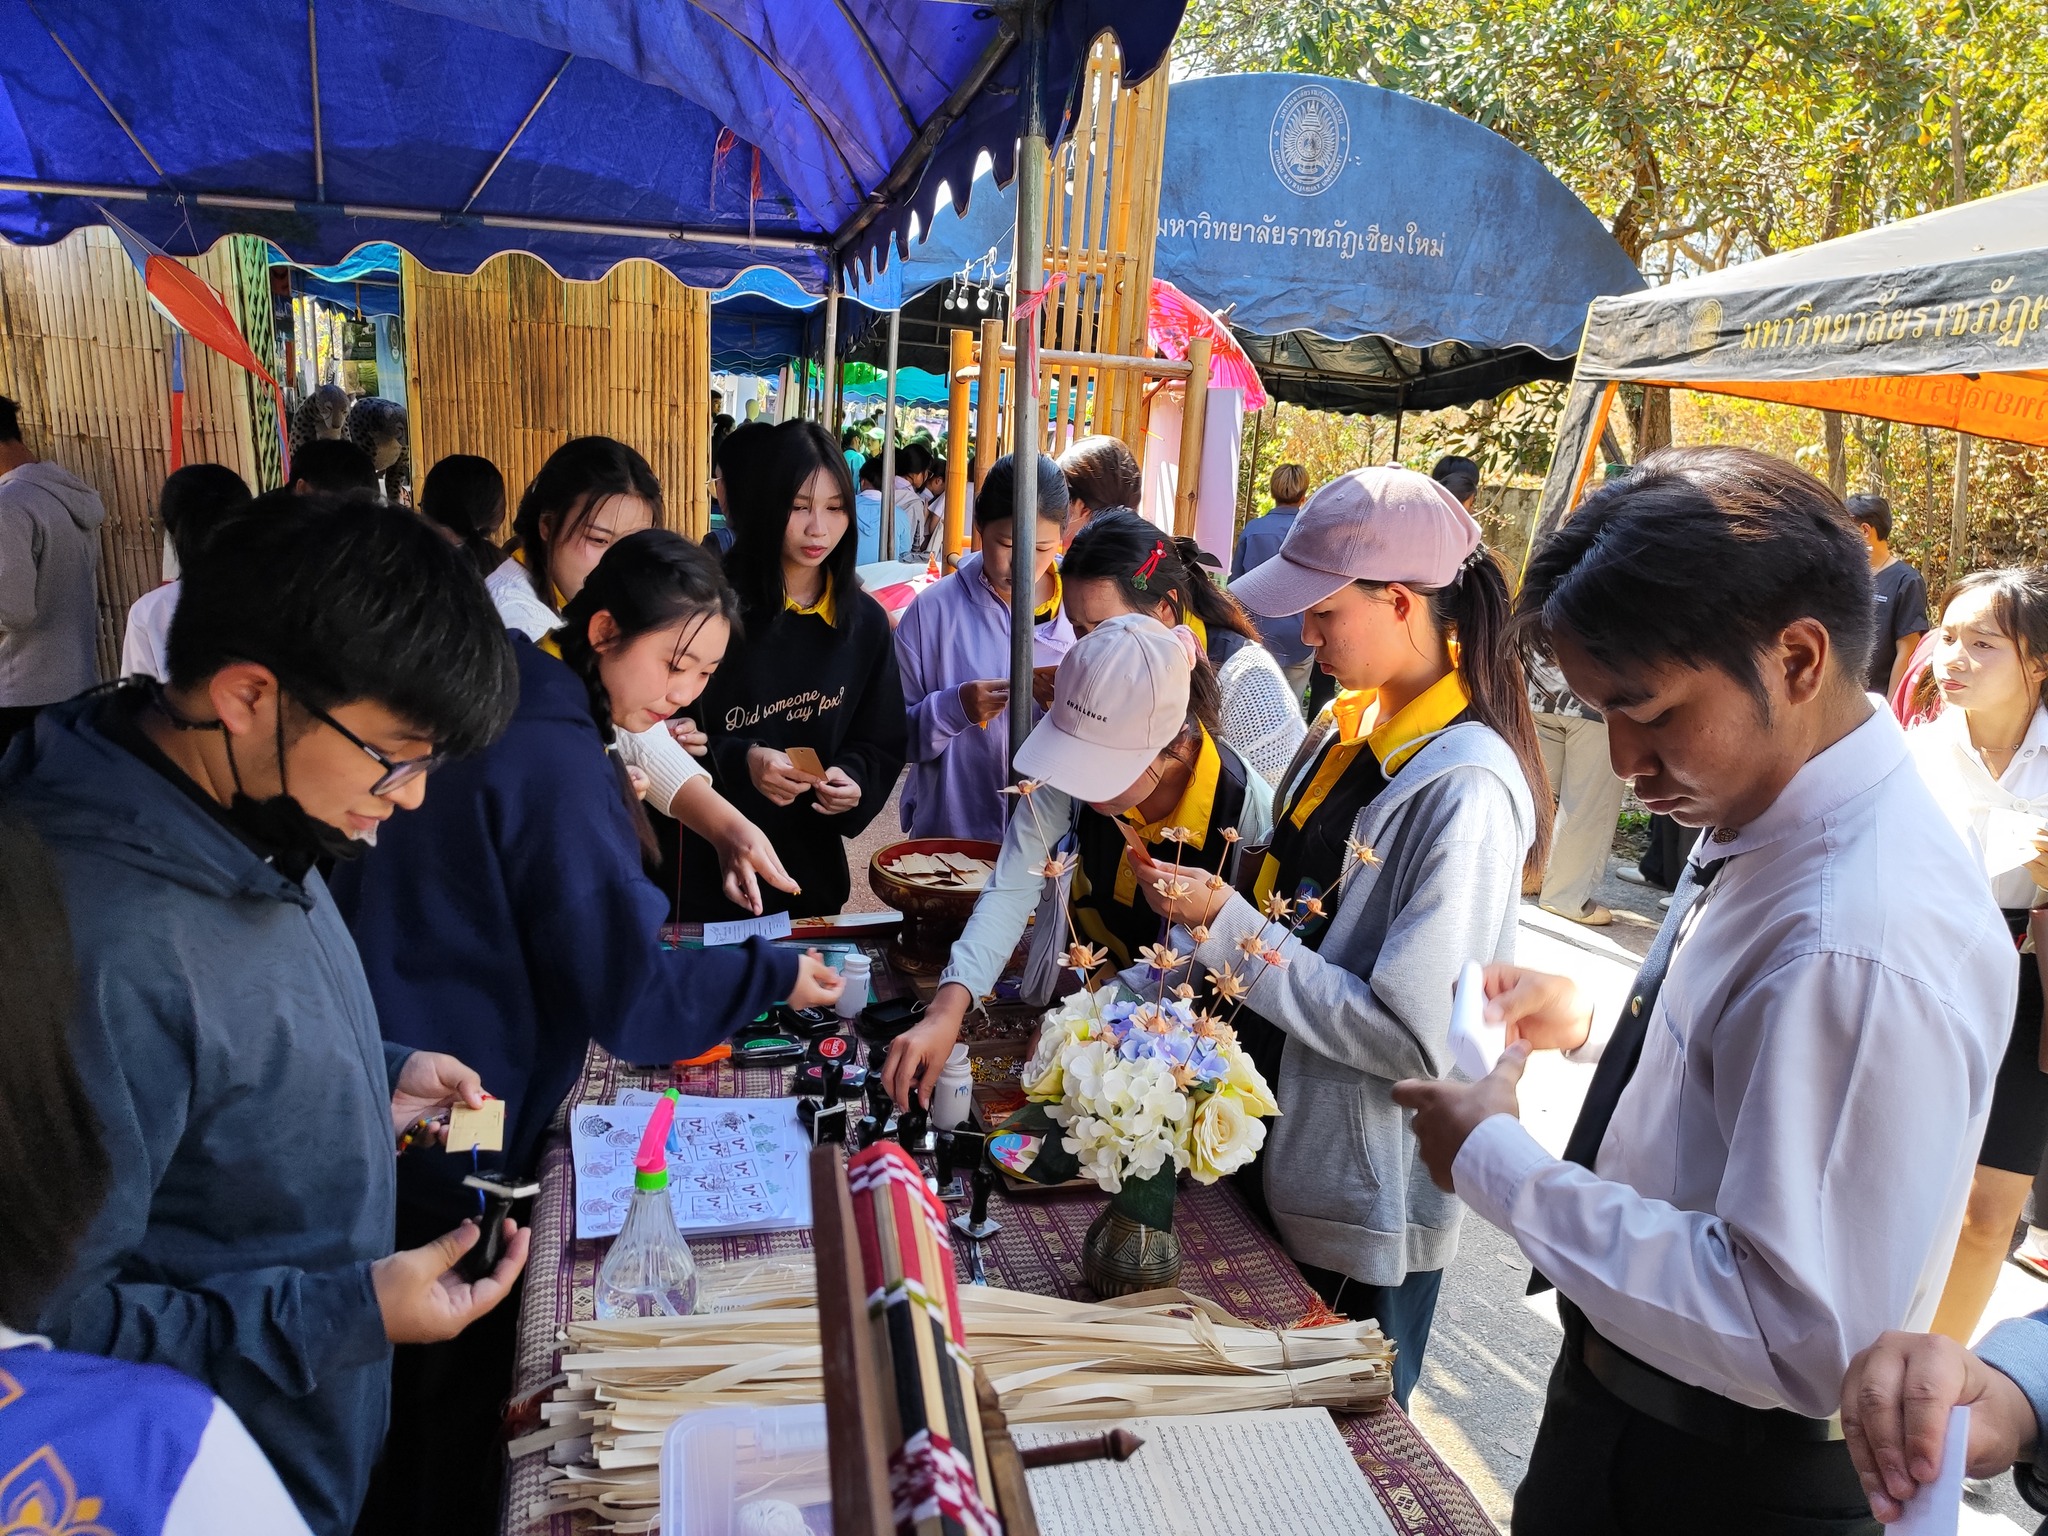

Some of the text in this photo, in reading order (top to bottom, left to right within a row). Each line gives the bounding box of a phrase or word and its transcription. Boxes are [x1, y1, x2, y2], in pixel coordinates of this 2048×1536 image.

[1157, 211, 1446, 259] มหาวิทยาลัยราชภัฏเชียงใหม่
[725, 690, 820, 731] Did someone
[786, 705, 813, 722] say
[1066, 699, 1108, 722] CHALLENGE
